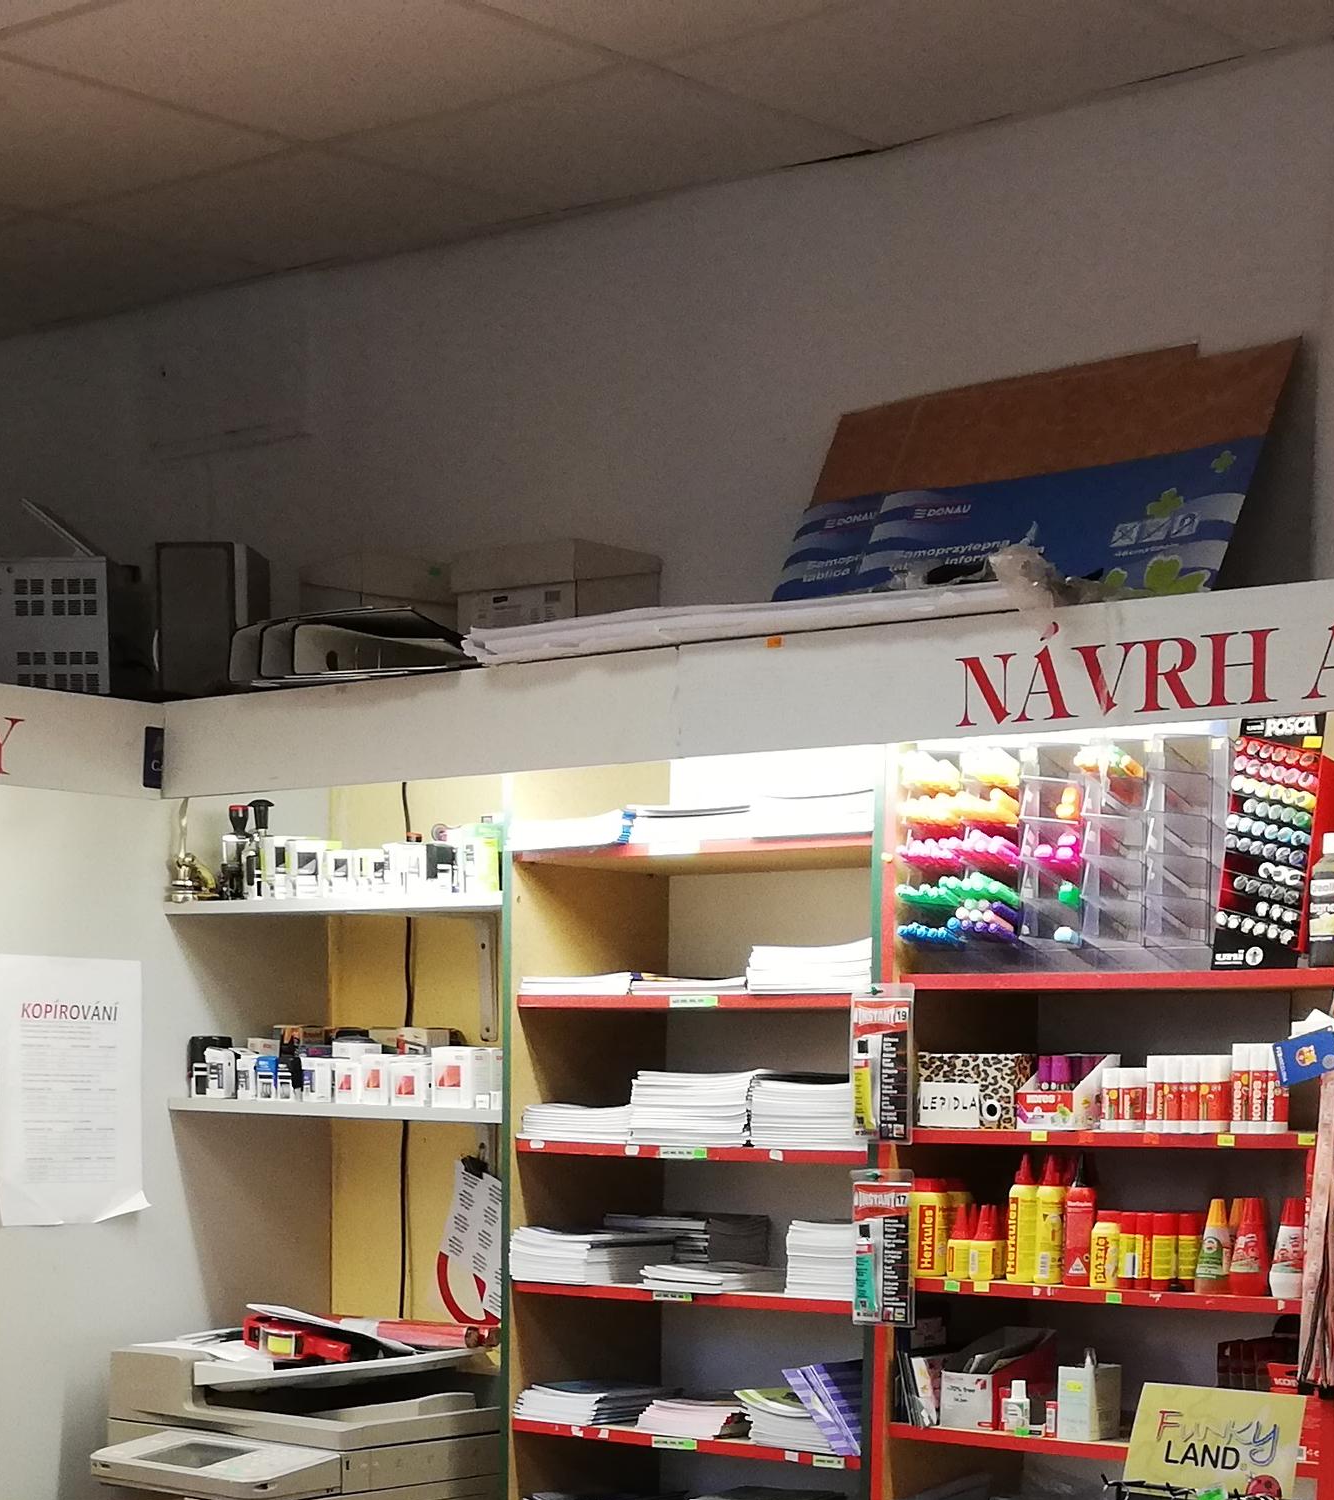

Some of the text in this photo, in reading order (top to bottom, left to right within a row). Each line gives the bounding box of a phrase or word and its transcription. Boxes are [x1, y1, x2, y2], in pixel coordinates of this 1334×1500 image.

[925, 504, 971, 518] DONAU
[956, 621, 1279, 729] NÁVRH
[1264, 715, 1317, 737] POSCA
[1215, 950, 1244, 962] uni
[20, 999, 119, 1024] KOPÍROVÁNÍ
[896, 1010, 909, 1023] 19
[922, 1096, 978, 1110] LEPIDLA
[896, 1194, 908, 1206] 17
[919, 1207, 936, 1271] Herkules
[1007, 1201, 1017, 1274] Herkules
[1163, 1439, 1240, 1470] LAND
